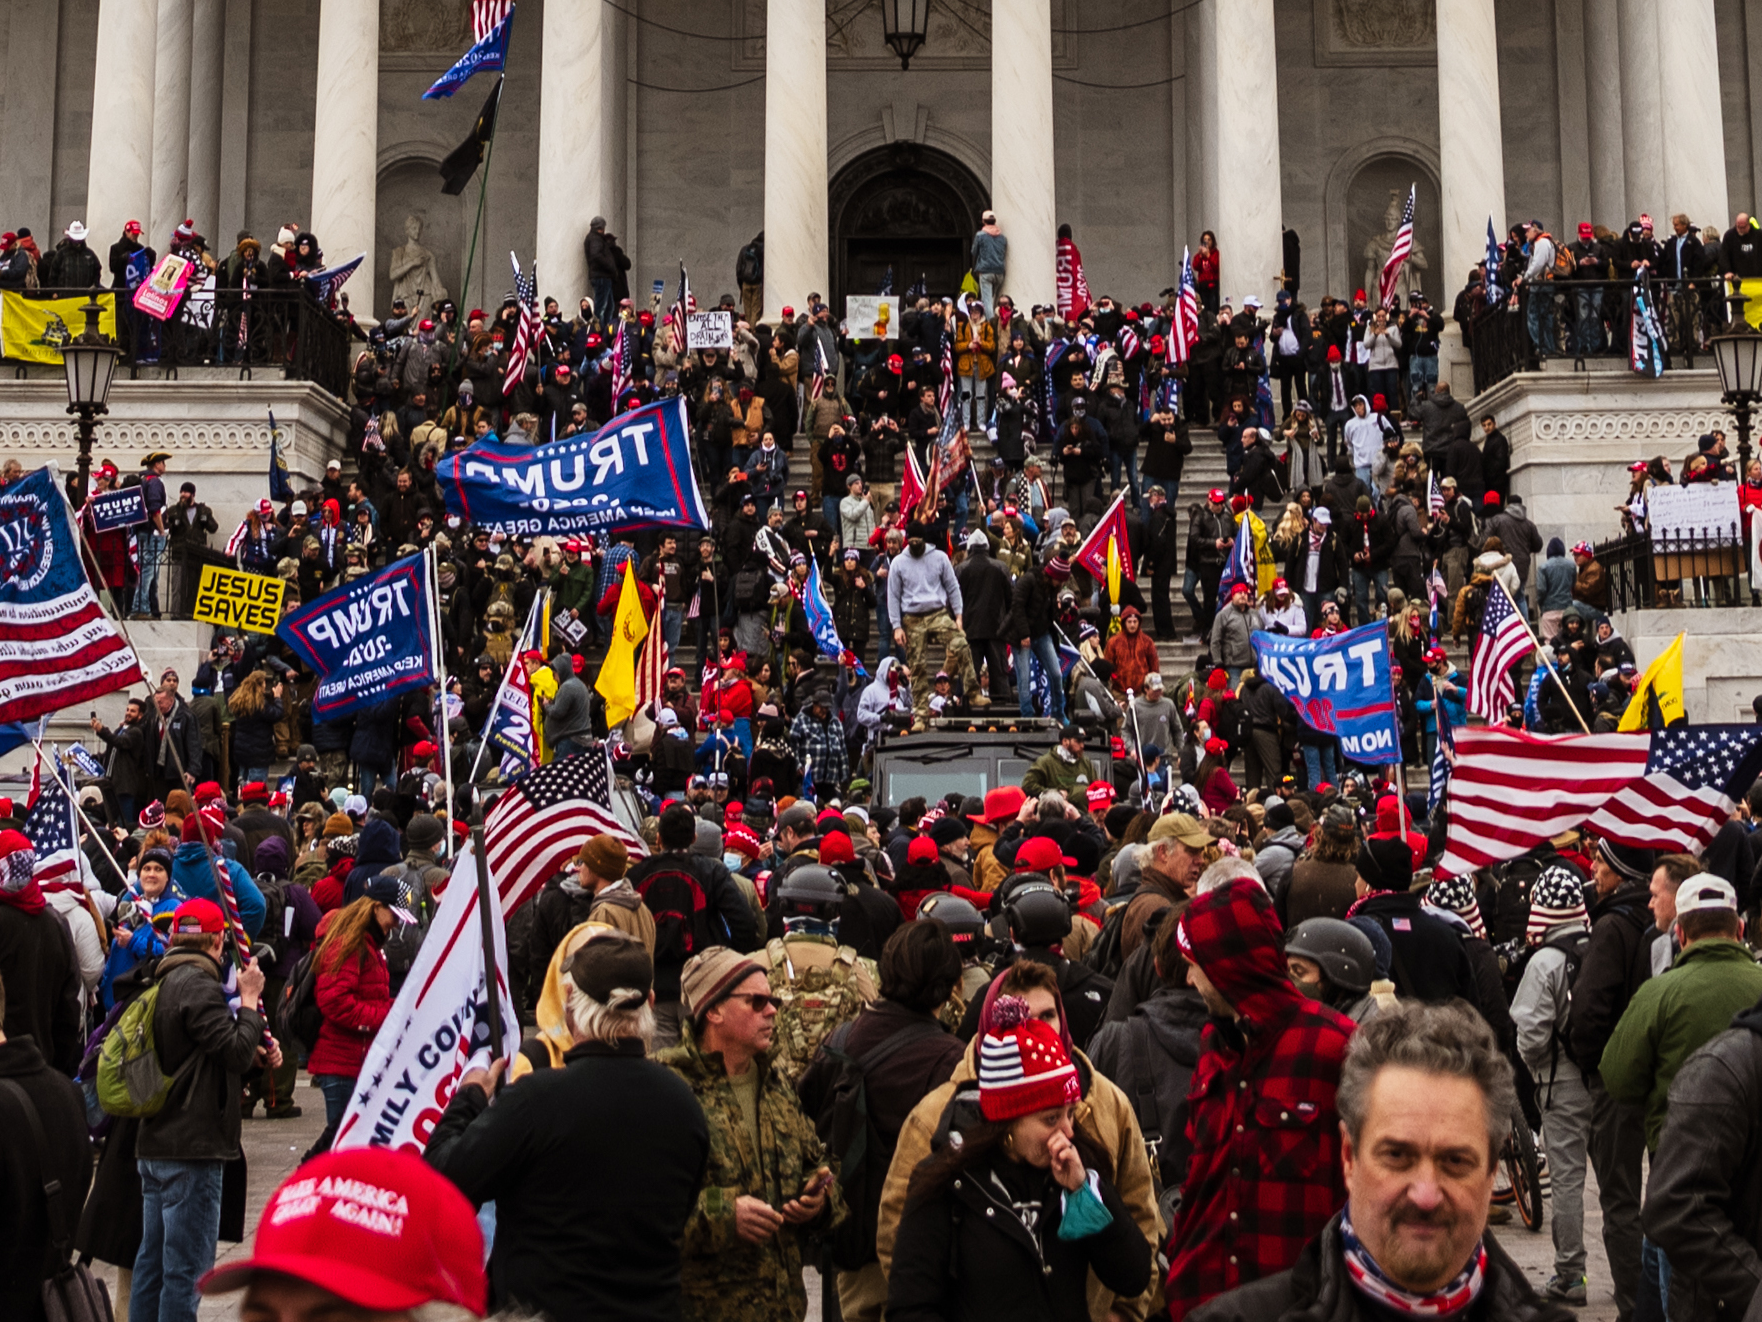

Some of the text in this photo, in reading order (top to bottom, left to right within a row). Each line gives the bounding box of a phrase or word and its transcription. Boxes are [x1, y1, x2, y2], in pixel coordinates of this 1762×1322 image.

[142, 289, 169, 306] Latinos
[94, 496, 142, 513] TRUMP
[99, 504, 139, 518] PENCE
[202, 572, 281, 604] JESUS
[196, 595, 280, 629] SAVES
[495, 732, 529, 758] President
[315, 1175, 409, 1217] AMERICA
[329, 1198, 405, 1238] AGAIN!
